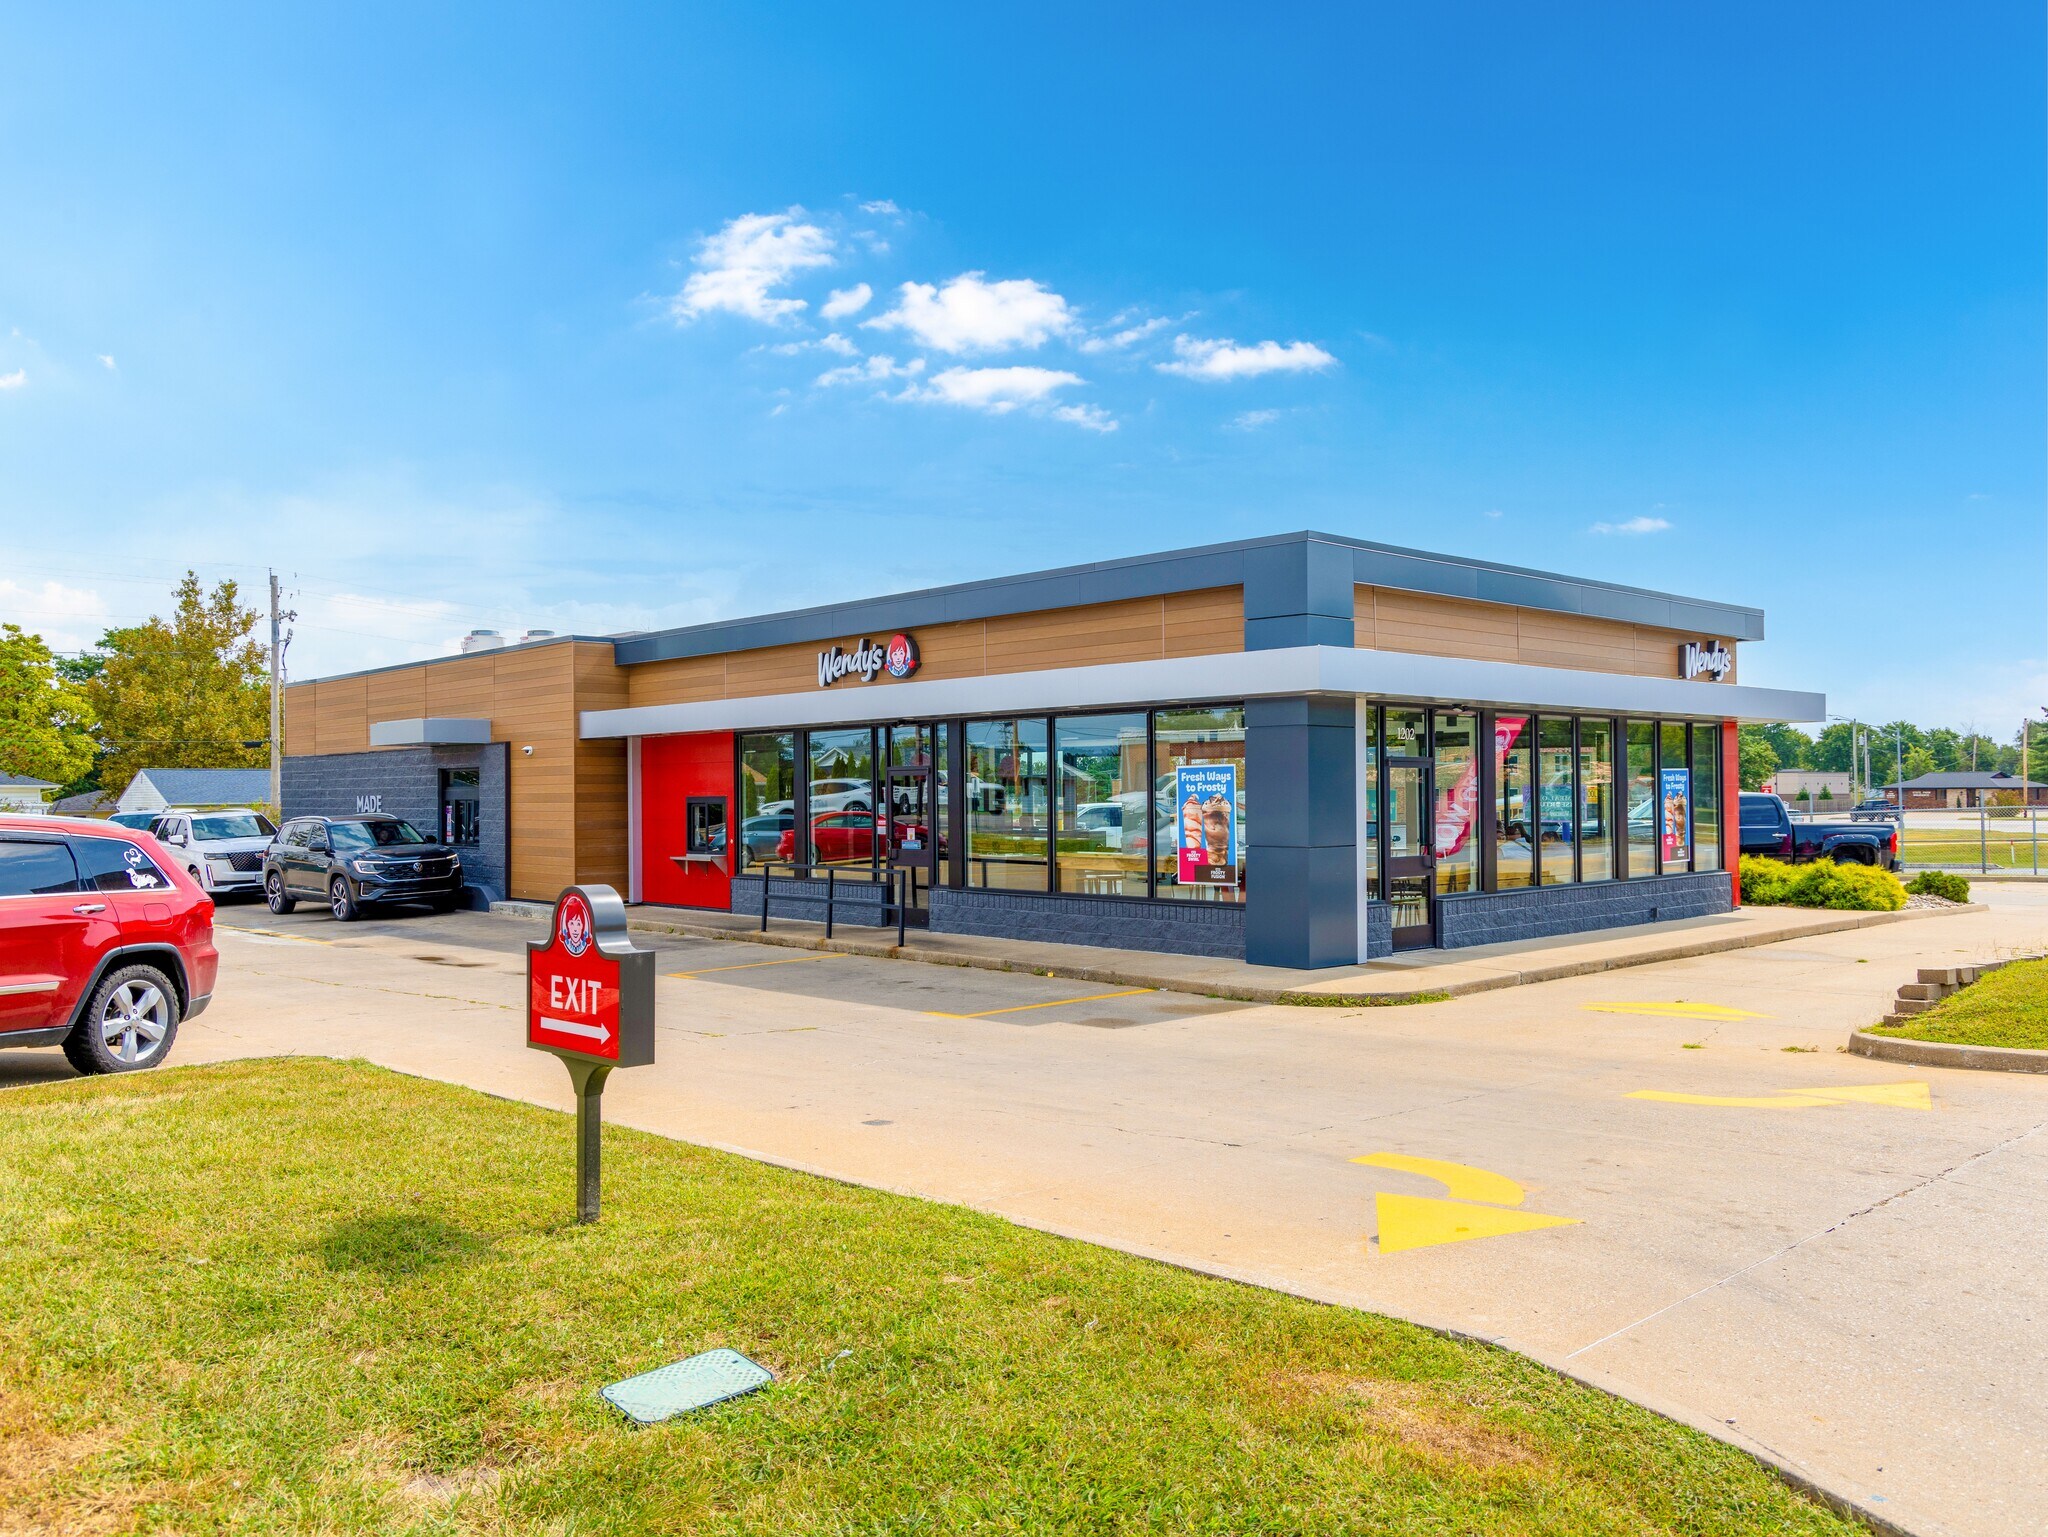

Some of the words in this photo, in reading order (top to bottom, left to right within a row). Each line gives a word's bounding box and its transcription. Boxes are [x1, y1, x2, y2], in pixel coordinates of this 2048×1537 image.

[817, 638, 883, 687] Wendy's
[1685, 640, 1731, 681] Wendy's
[1397, 727, 1415, 740] 1202
[1181, 771, 1205, 781] Fresh
[1206, 771, 1231, 783] Ways
[1185, 783, 1196, 792] to
[1197, 782, 1227, 794] Frosty
[356, 795, 382, 813] MADE
[551, 974, 602, 1015] EXIT
